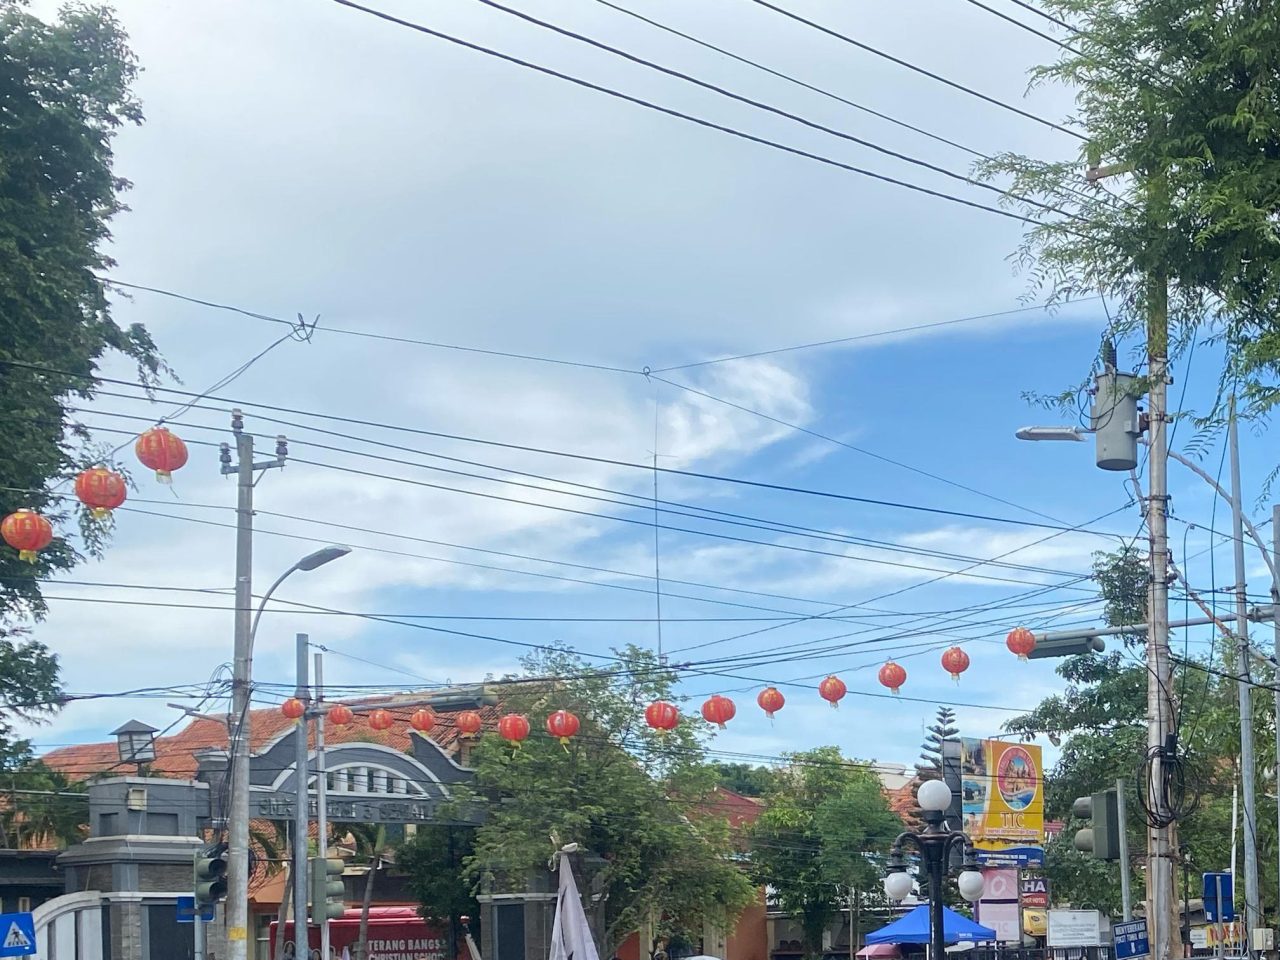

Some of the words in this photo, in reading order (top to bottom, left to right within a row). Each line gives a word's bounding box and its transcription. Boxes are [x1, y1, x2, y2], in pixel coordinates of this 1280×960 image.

[1000, 812, 1025, 829] TIC
[1021, 881, 1046, 892] HA
[368, 940, 405, 951] TERANG
